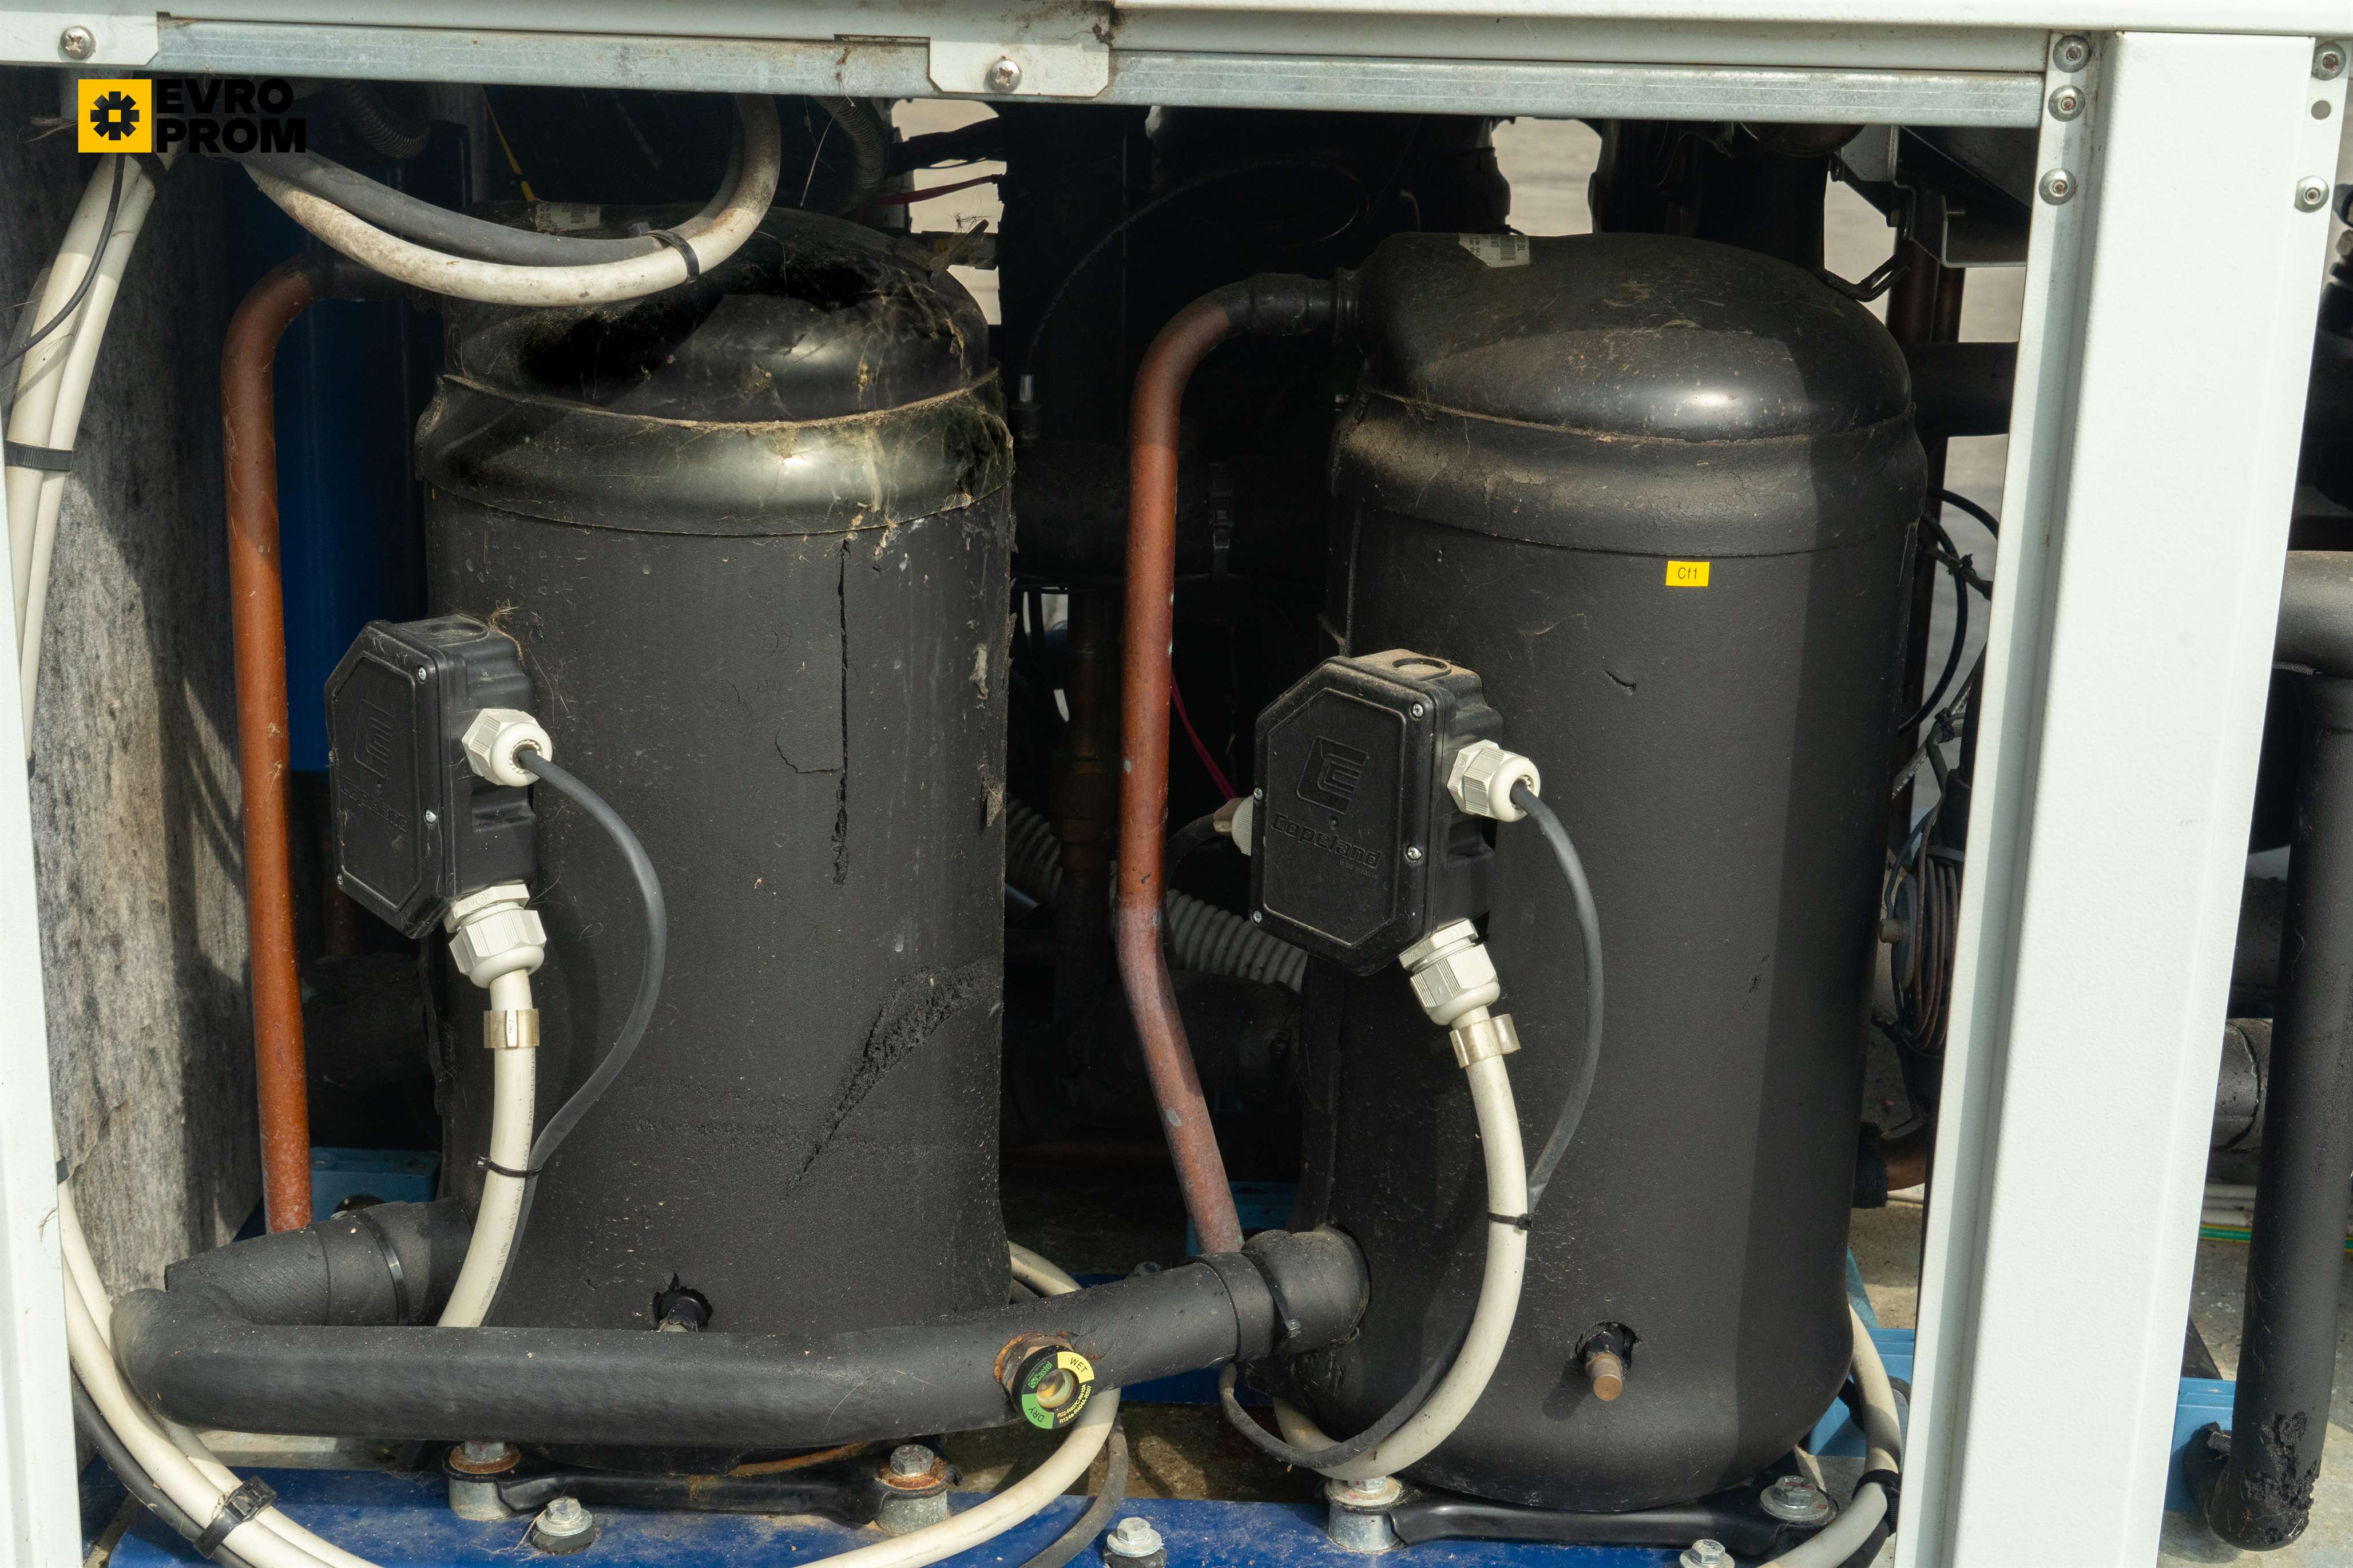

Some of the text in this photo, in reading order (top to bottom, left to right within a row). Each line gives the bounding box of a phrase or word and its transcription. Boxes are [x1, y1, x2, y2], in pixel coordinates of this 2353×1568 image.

[1678, 567, 1697, 579] Cf1
[1271, 812, 1382, 870] Copeland
[1070, 1357, 1088, 1372] WET
[1029, 1407, 1045, 1422] DRY
